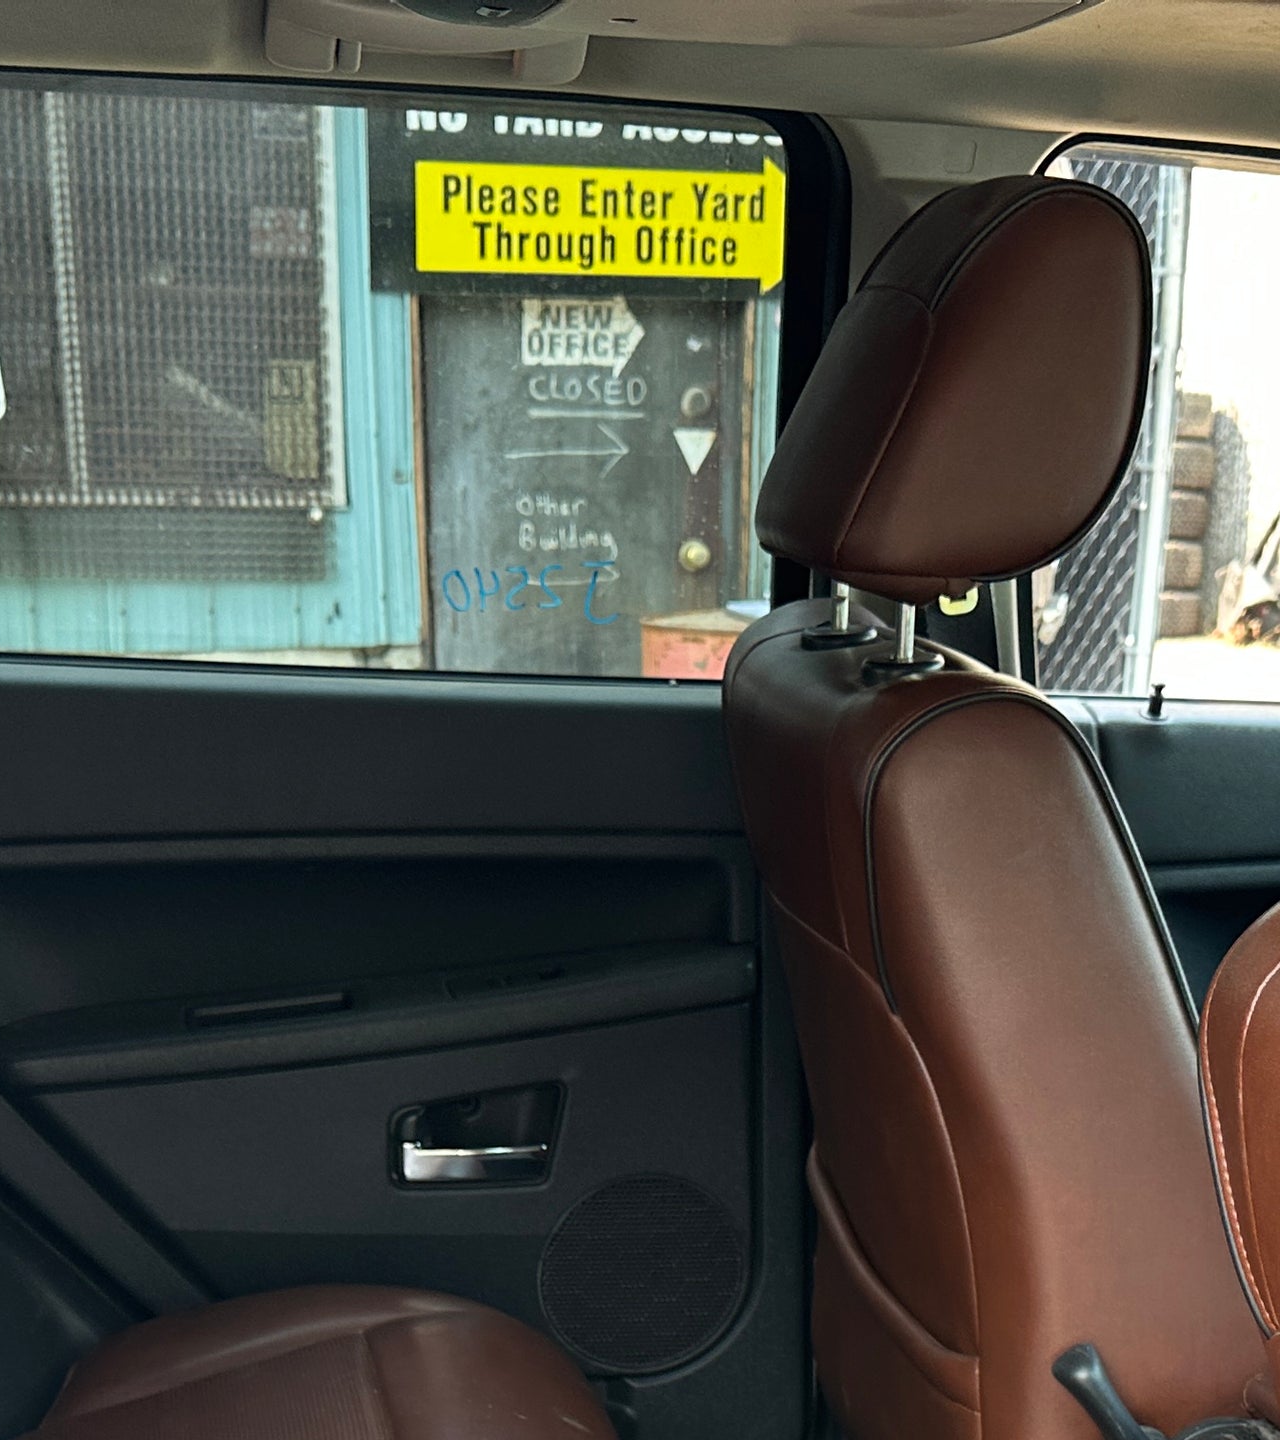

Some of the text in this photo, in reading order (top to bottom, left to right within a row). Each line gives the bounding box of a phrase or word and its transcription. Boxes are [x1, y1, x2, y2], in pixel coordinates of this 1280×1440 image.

[442, 174, 766, 223] Please Enter Yard
[472, 222, 737, 269] Through Office
[539, 303, 612, 329] NEW
[528, 329, 630, 357] OFFICE
[529, 373, 647, 405] CLOSED
